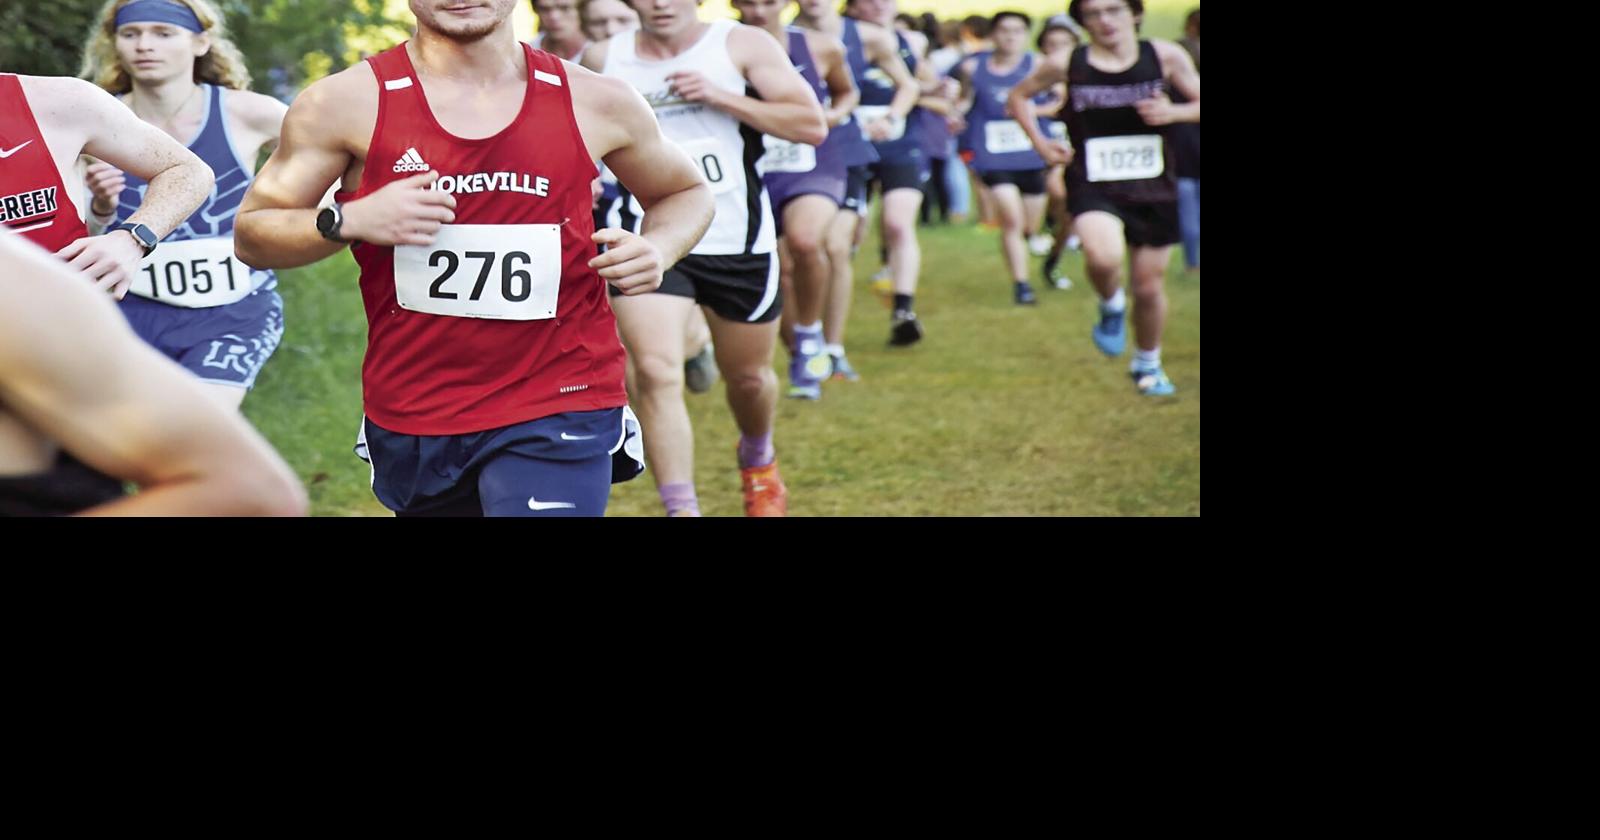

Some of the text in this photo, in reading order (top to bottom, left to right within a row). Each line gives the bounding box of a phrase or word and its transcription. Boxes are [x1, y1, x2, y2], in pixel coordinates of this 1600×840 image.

[1098, 146, 1154, 169] 1028
[142, 256, 236, 299] 1051
[428, 249, 531, 303] 276
